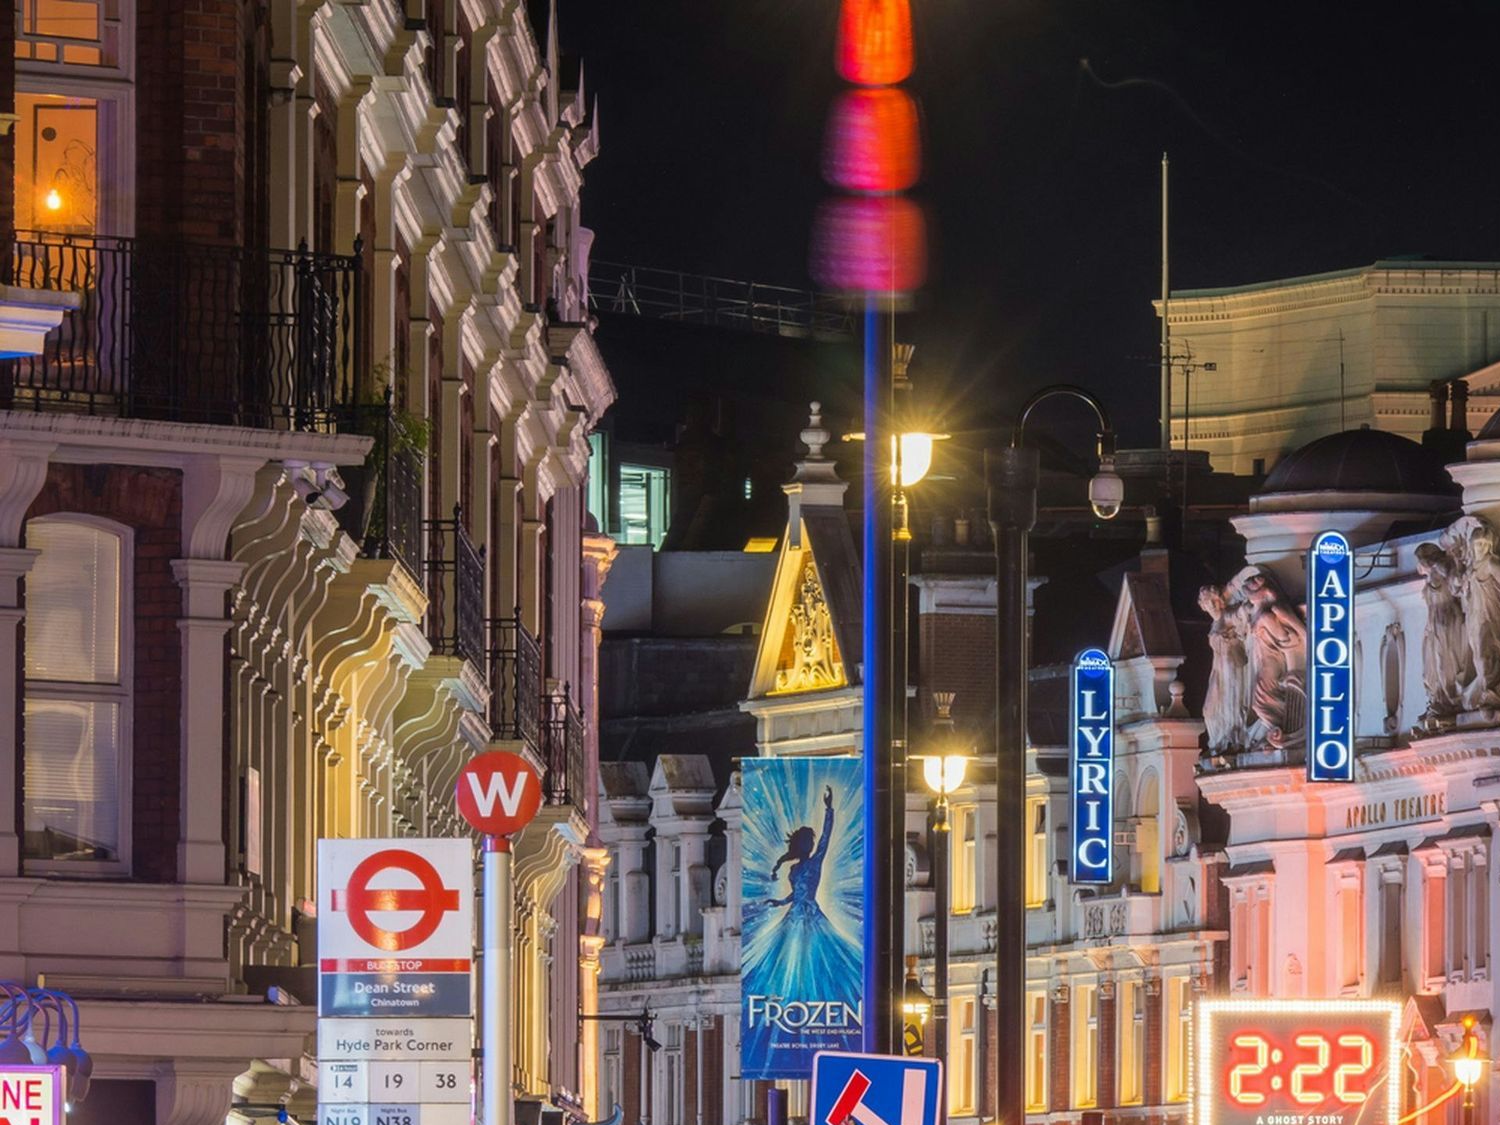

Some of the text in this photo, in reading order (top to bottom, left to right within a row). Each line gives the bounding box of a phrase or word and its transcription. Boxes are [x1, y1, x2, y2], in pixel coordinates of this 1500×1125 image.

[1315, 569, 1348, 770] APOLLO
[1078, 690, 1110, 868] LYRIC
[465, 771, 529, 818] W
[1345, 791, 1446, 830] APOLLO THEATRE
[354, 982, 436, 994] Dean Street
[370, 998, 420, 1007] Chinatown
[748, 994, 863, 1034] FROZEN
[375, 1028, 414, 1036] towards
[336, 1039, 453, 1053] Hyde Park Corner
[1229, 1036, 1373, 1104] 2:22
[334, 1074, 353, 1089] 14
[384, 1074, 404, 1089] 19
[435, 1074, 457, 1089] 38
[1267, 1115, 1304, 1125] GHOST
[1308, 1115, 1344, 1125] STORY
